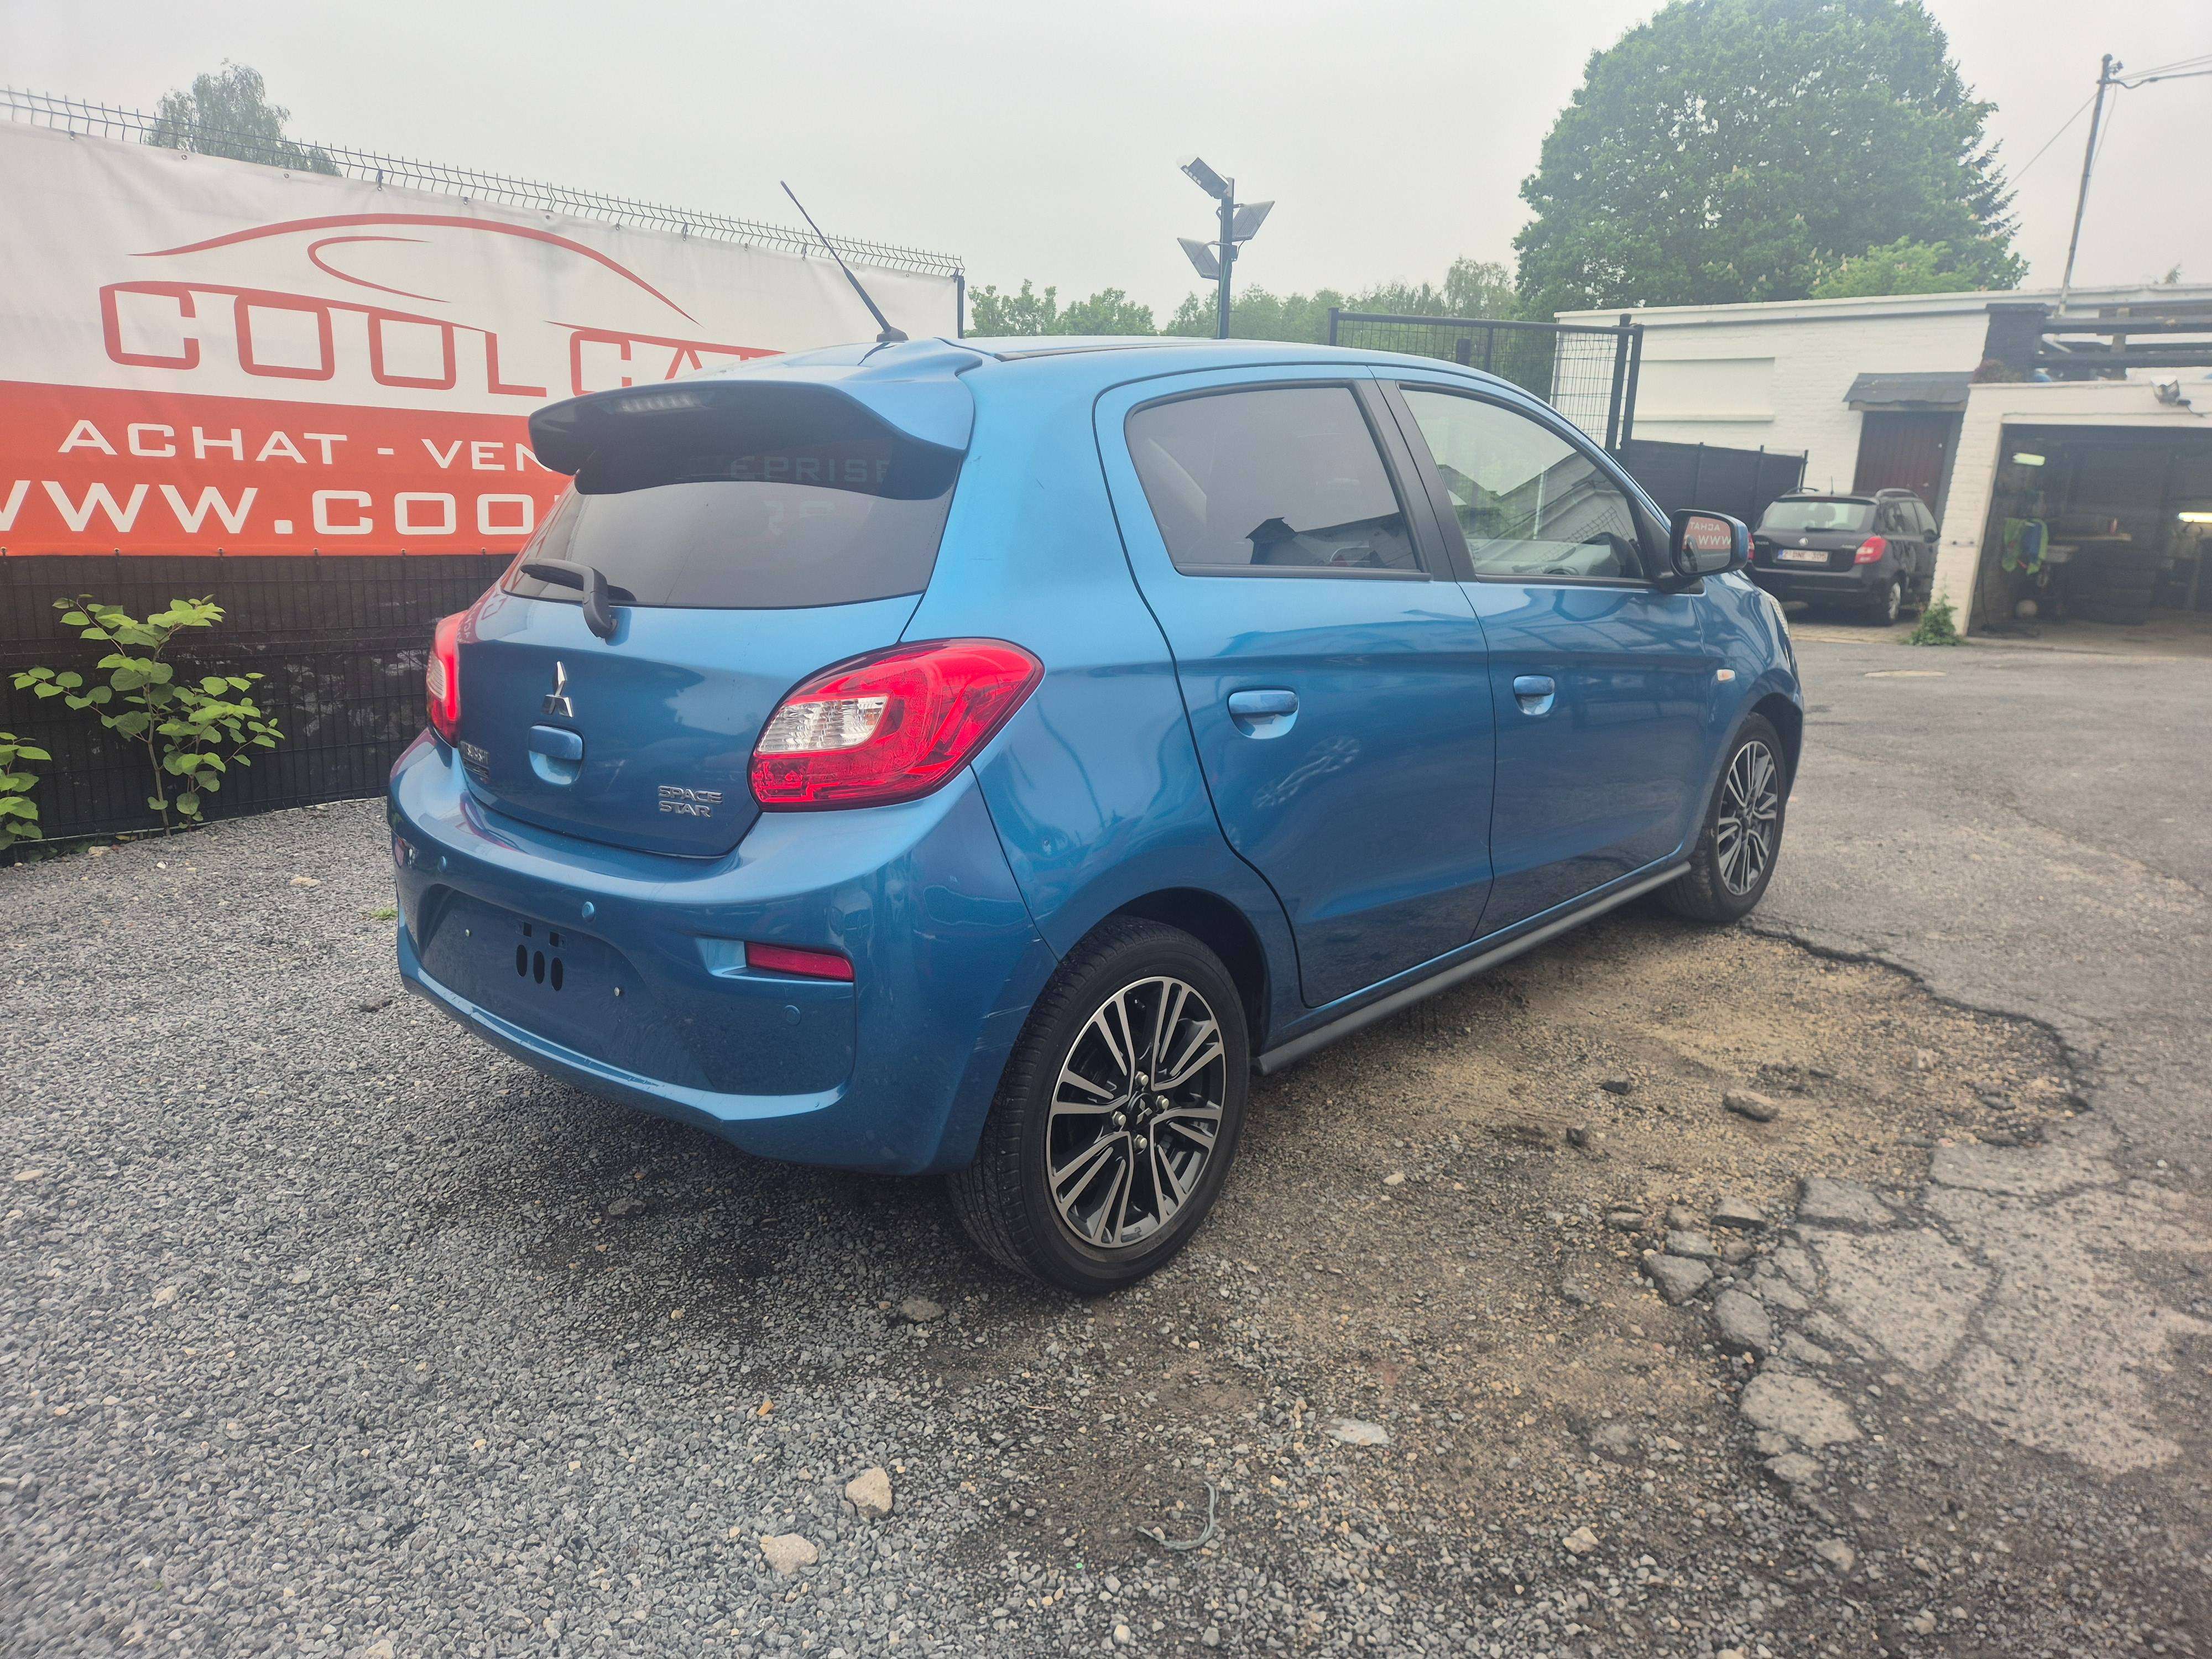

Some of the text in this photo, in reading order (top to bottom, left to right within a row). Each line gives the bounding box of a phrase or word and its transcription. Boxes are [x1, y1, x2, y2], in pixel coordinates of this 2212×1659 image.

[58, 419, 347, 465] ACHAT
[0, 479, 562, 536] WW.COO
[658, 785, 723, 805] SPACE
[659, 800, 712, 818] STAR
